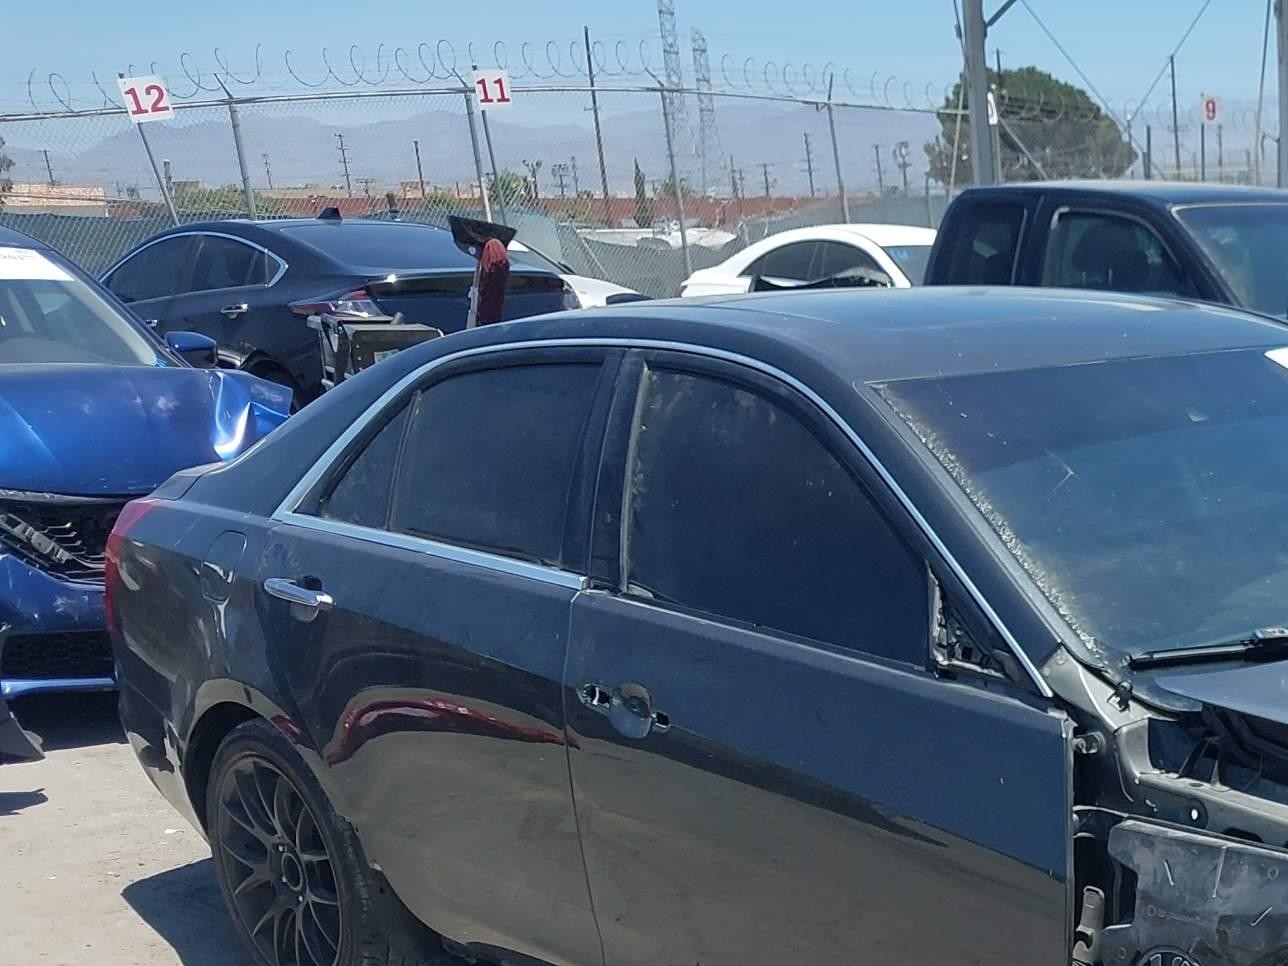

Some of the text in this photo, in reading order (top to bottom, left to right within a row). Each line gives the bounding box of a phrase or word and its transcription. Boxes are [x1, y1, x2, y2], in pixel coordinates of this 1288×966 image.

[124, 84, 170, 116] 12
[476, 78, 510, 103] 11
[1205, 99, 1216, 121] 9
